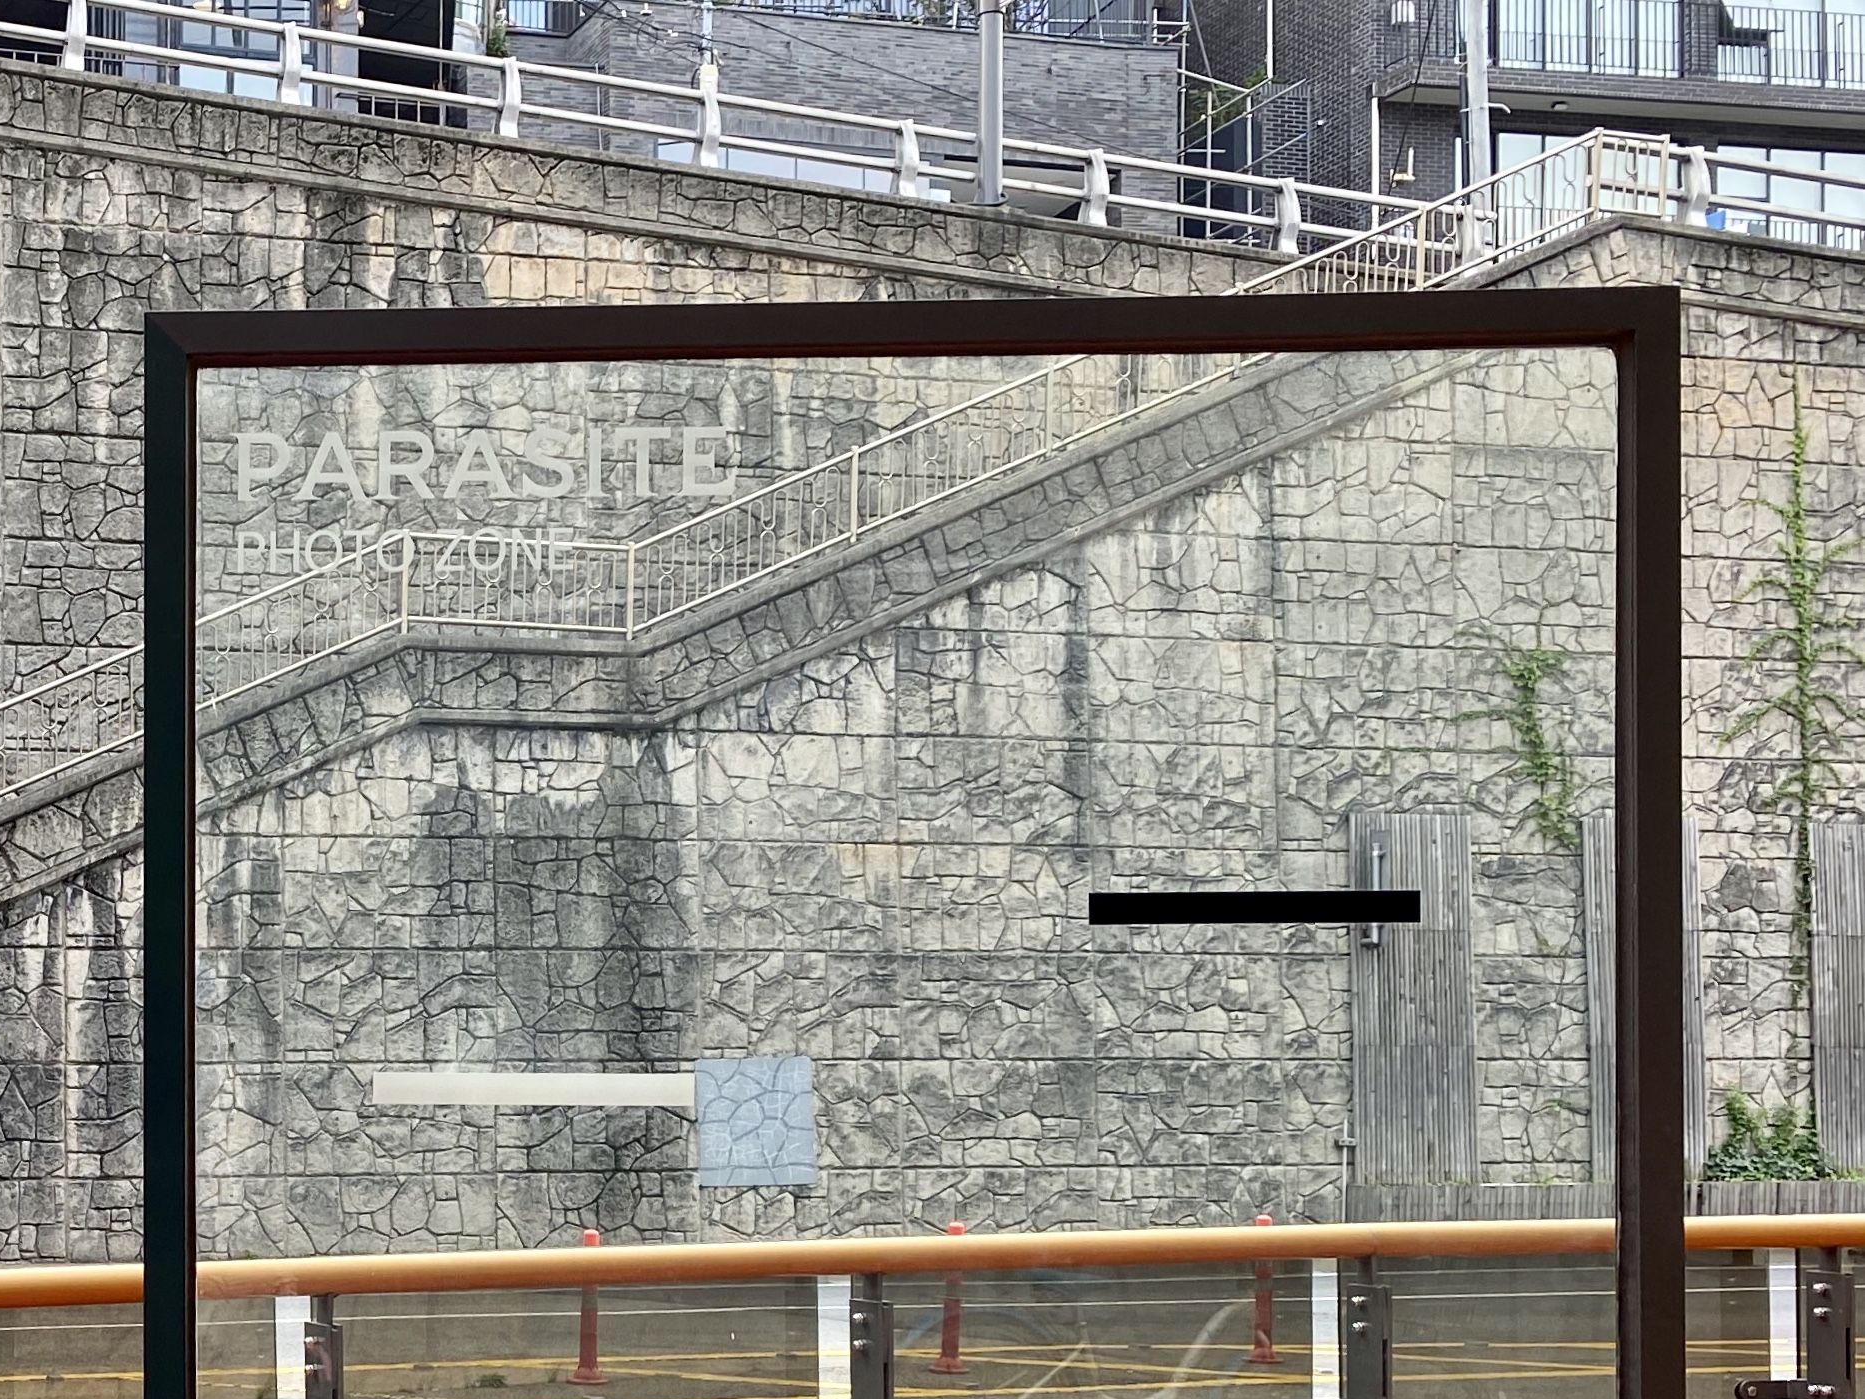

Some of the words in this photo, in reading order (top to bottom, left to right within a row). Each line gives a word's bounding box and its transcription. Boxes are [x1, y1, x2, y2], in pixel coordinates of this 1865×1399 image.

[234, 427, 737, 502] PARASITE
[236, 528, 411, 575] PHOTO
[434, 526, 575, 573] ZONE
